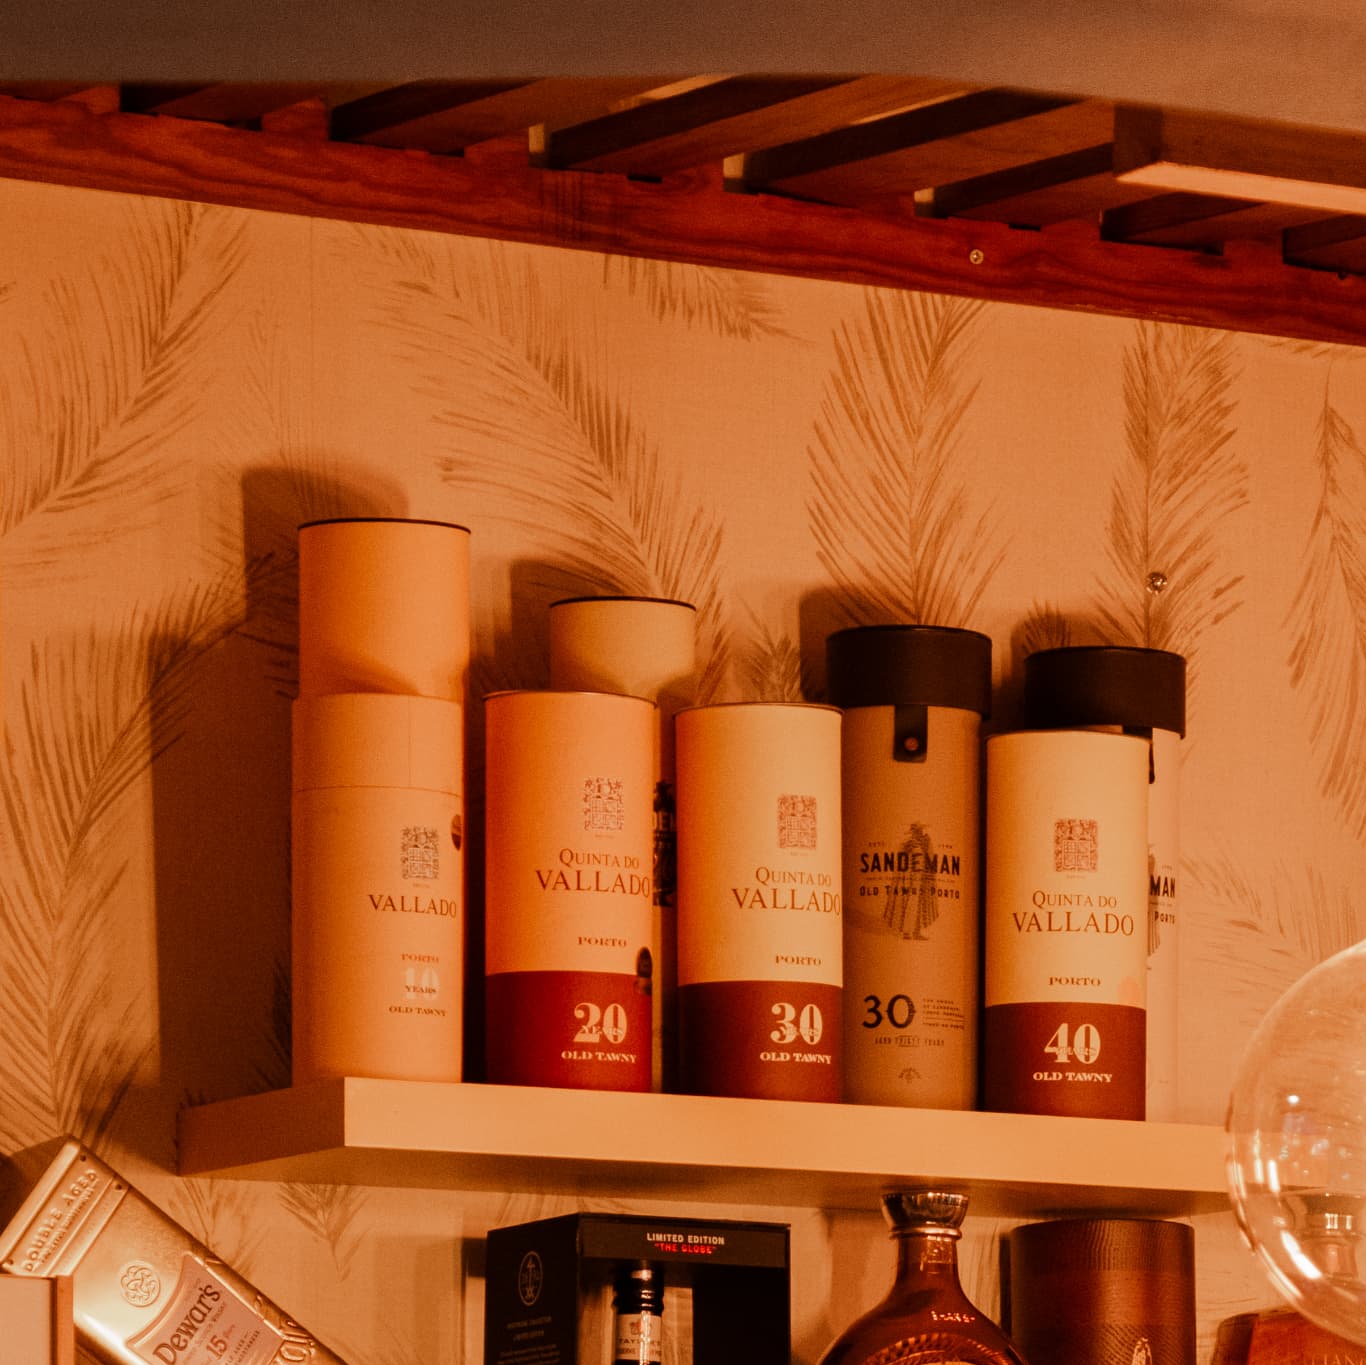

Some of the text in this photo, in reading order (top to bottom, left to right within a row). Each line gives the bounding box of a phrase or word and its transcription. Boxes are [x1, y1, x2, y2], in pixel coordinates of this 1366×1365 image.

[559, 848, 640, 869] QUINTA DO
[860, 852, 961, 876] SANDEMAN
[535, 870, 650, 899] VALLADO
[755, 866, 832, 887] QUINTA DO
[368, 894, 457, 918] VALLADO
[731, 888, 841, 917] VALLADO
[1032, 890, 1118, 909] QUINTA DO
[1012, 911, 1134, 937] VALLADO
[577, 936, 628, 948] PORTO
[775, 955, 821, 966] PORTO
[1048, 976, 1102, 987] PORTO
[862, 994, 916, 1029] 30
[572, 1002, 628, 1044] 20
[770, 1002, 824, 1045] 30
[1043, 1022, 1101, 1064] 40
[561, 1051, 637, 1063] OLD TAWNY
[760, 1052, 832, 1065] OLD TAWNY
[1032, 1071, 1113, 1083] OLD TAWNY
[647, 1232, 725, 1246] LIMITED EDITION
[206, 1335, 227, 1360] 15
